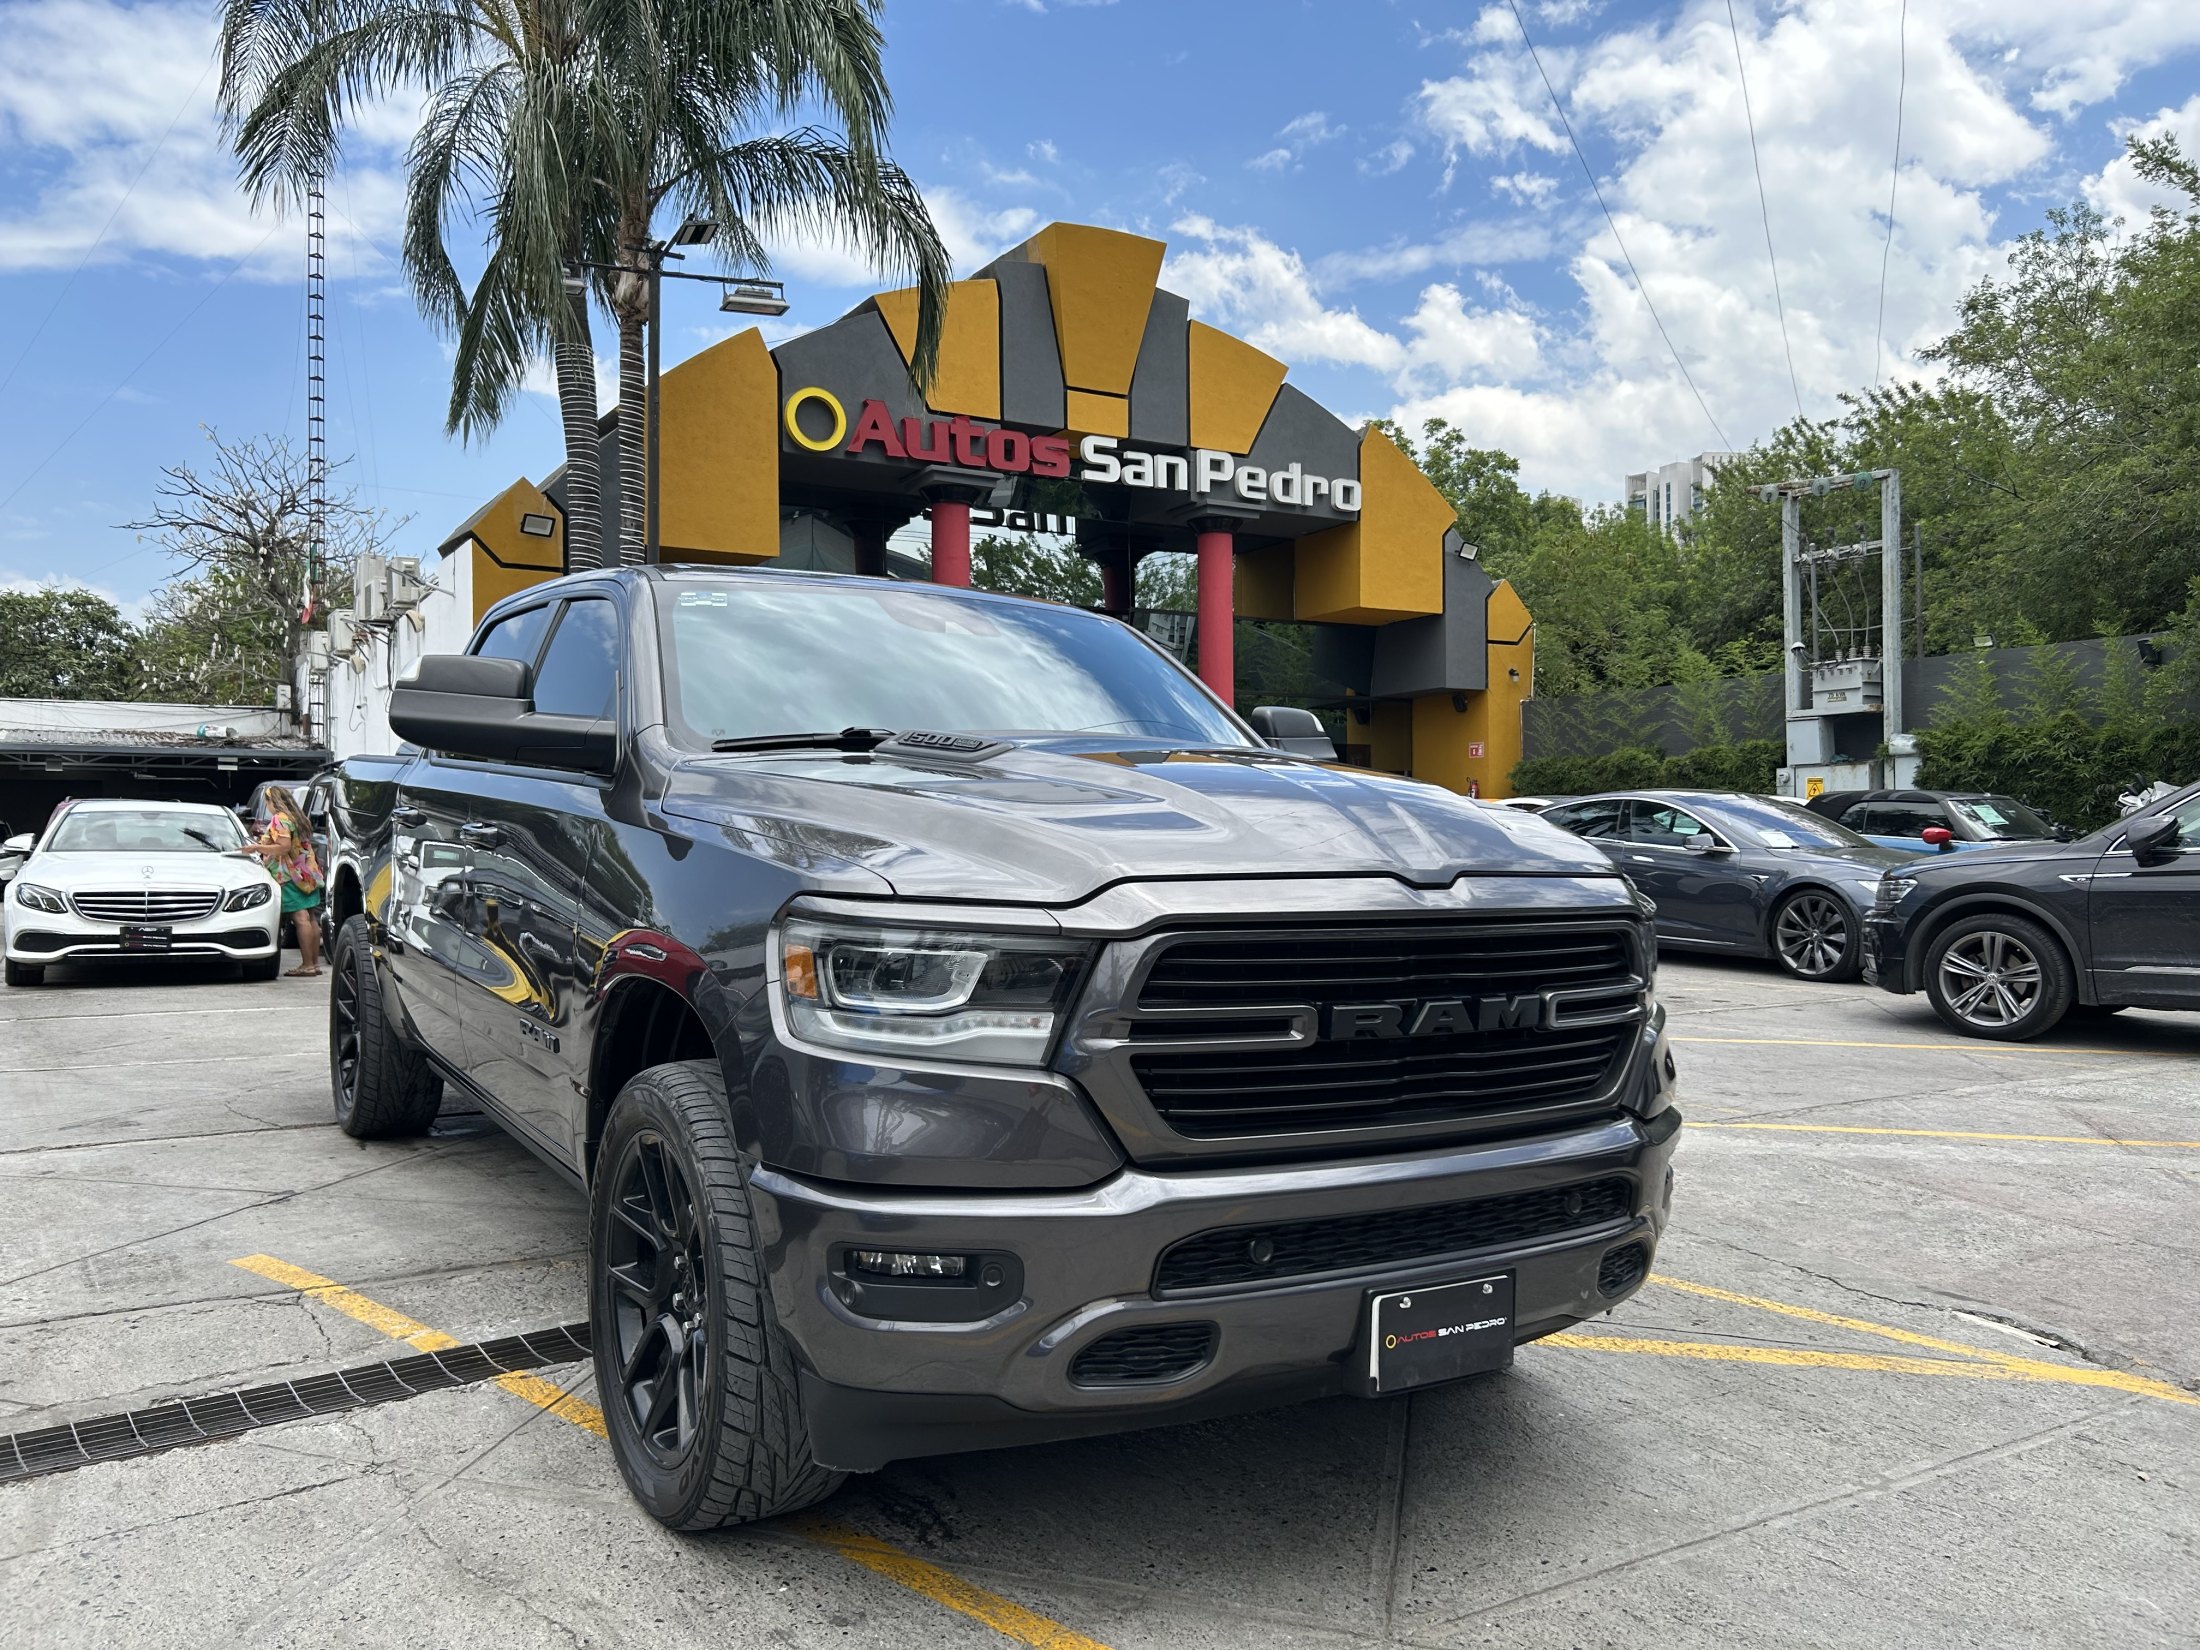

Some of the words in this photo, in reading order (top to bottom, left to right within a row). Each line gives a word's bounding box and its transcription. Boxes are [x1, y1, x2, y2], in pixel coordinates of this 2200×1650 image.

[847, 398, 1070, 477] Autos
[903, 731, 957, 747] 1500
[1332, 994, 1540, 1040] RAM
[519, 1018, 560, 1054] RAM
[1397, 1330, 1437, 1344] AUTOS
[1438, 1324, 1464, 1337] SAN
[1465, 1318, 1505, 1332] PEDRO
